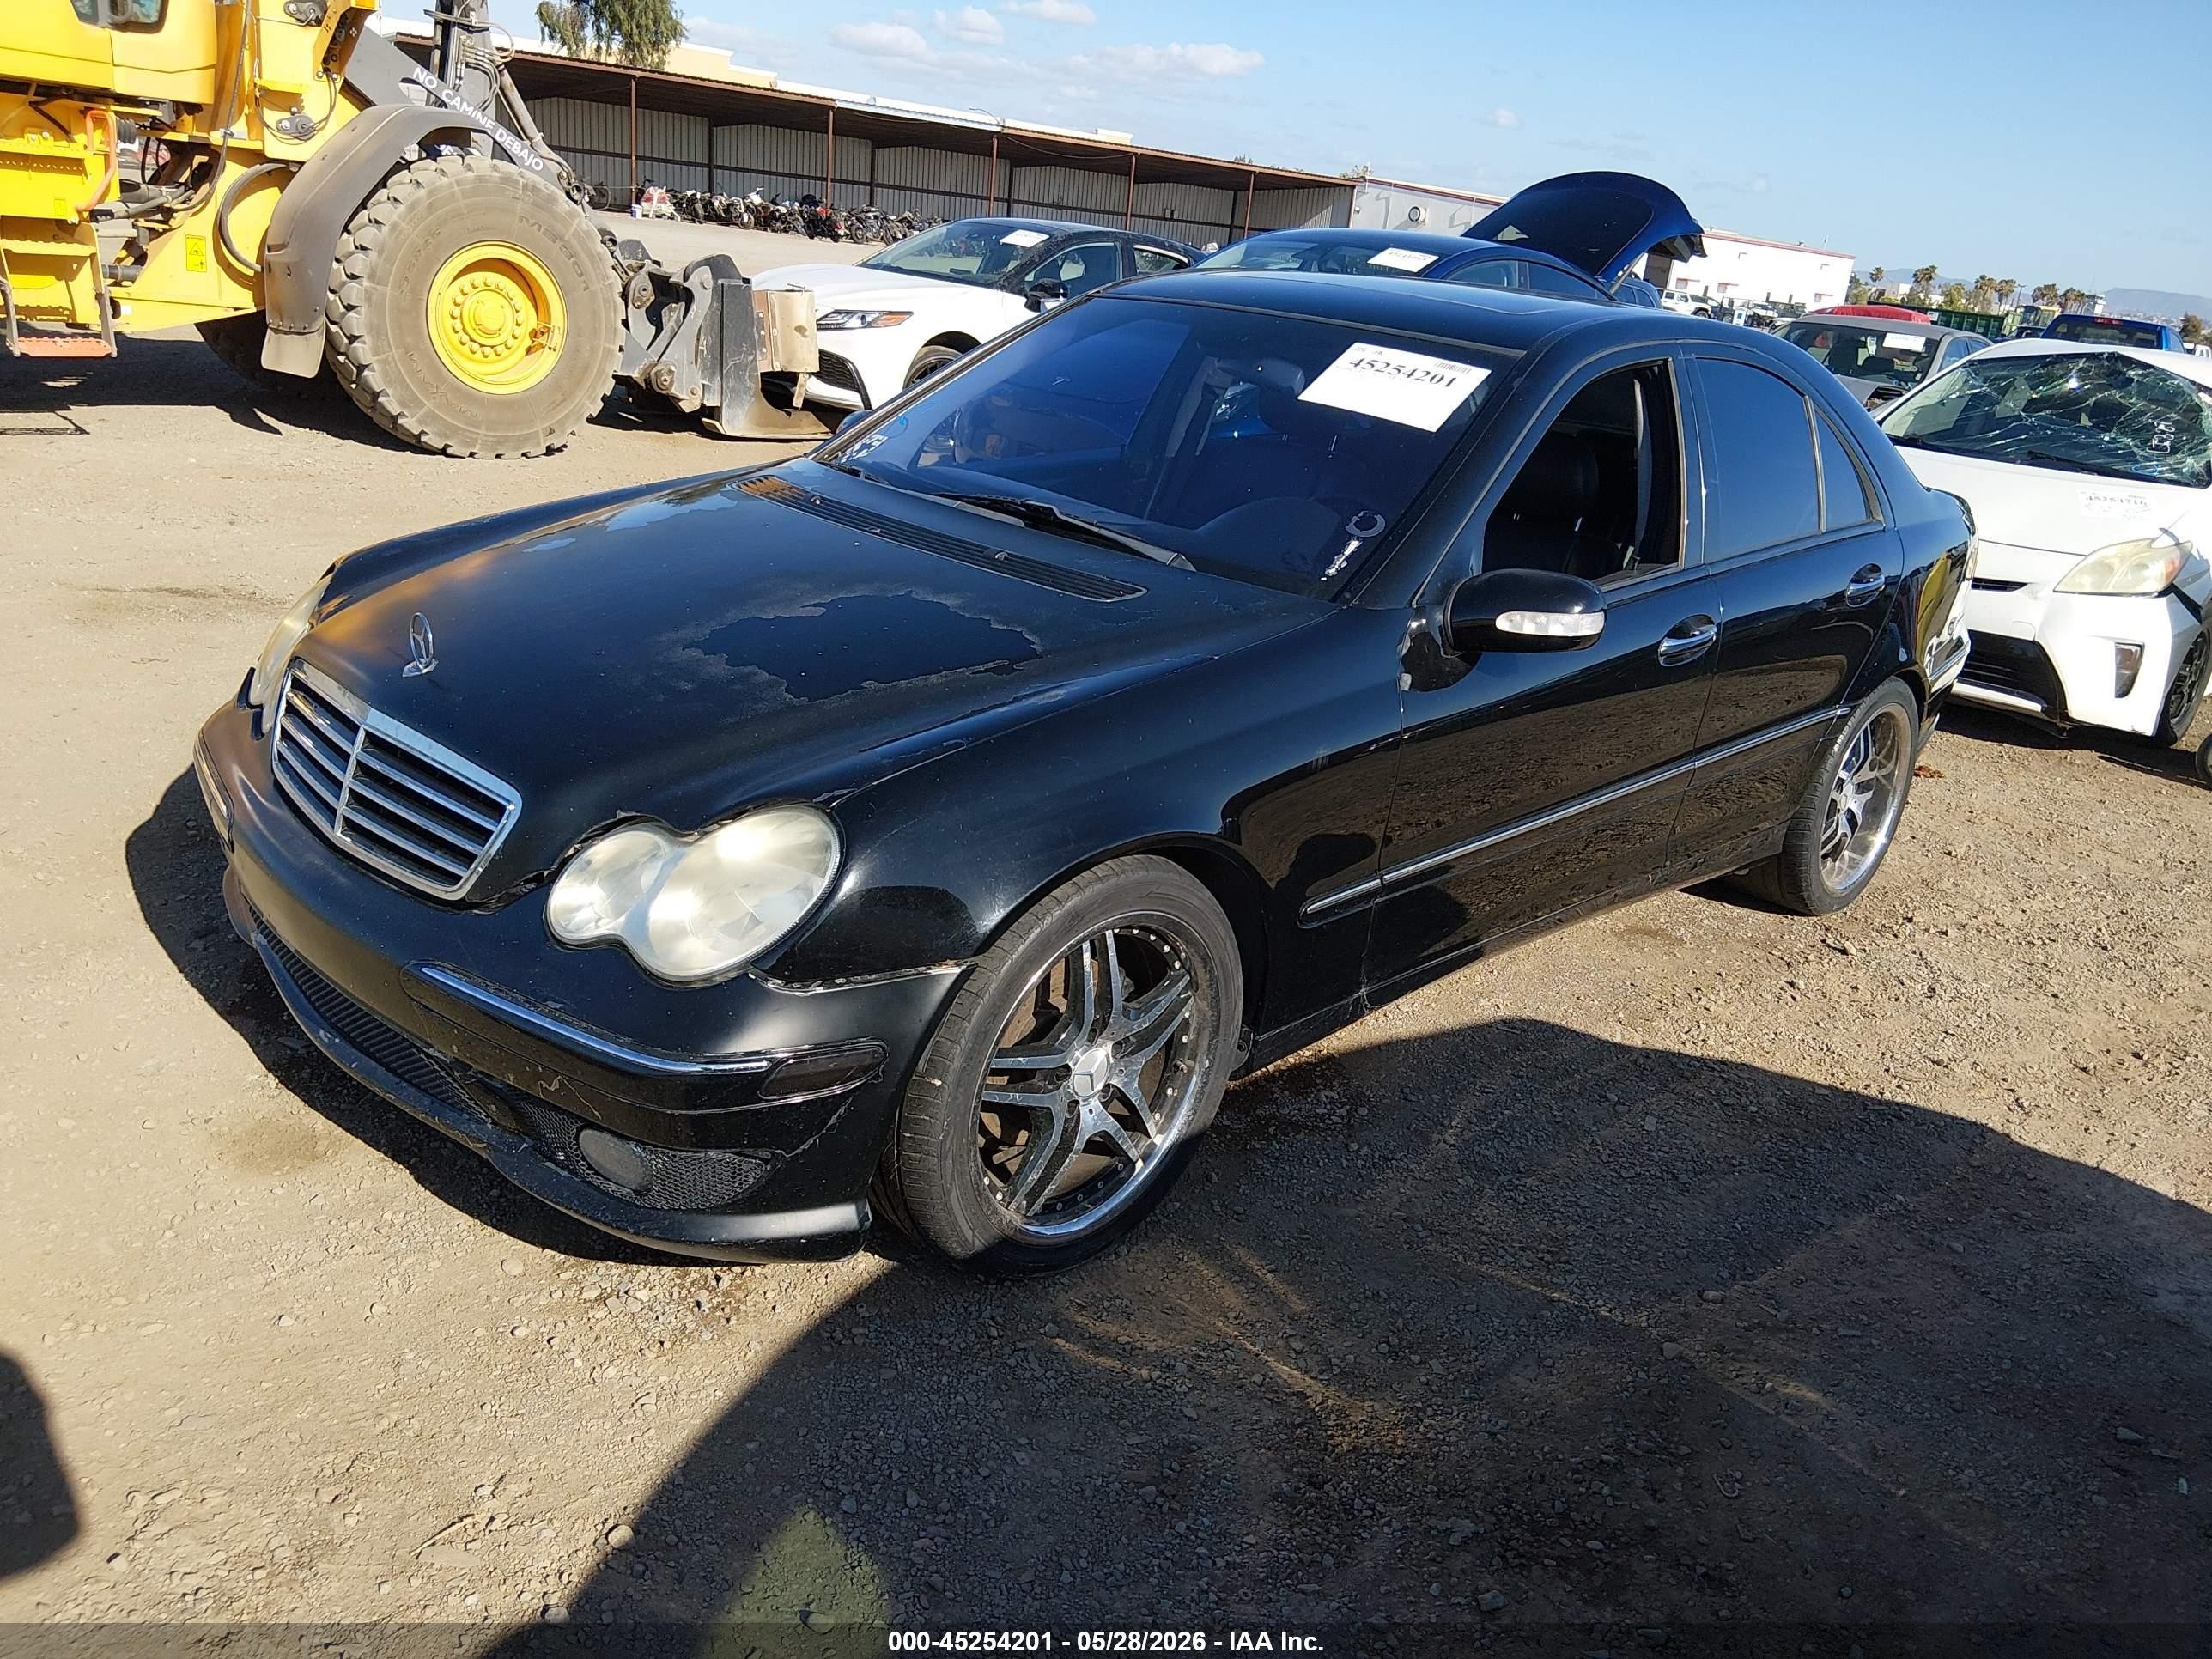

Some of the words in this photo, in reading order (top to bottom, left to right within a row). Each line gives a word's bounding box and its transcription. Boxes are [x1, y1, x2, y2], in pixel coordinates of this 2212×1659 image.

[413, 67, 438, 89] NO
[441, 89, 495, 135] CAMINE
[494, 128, 544, 172] DEBAJO
[1350, 357, 1456, 387] 45254201
